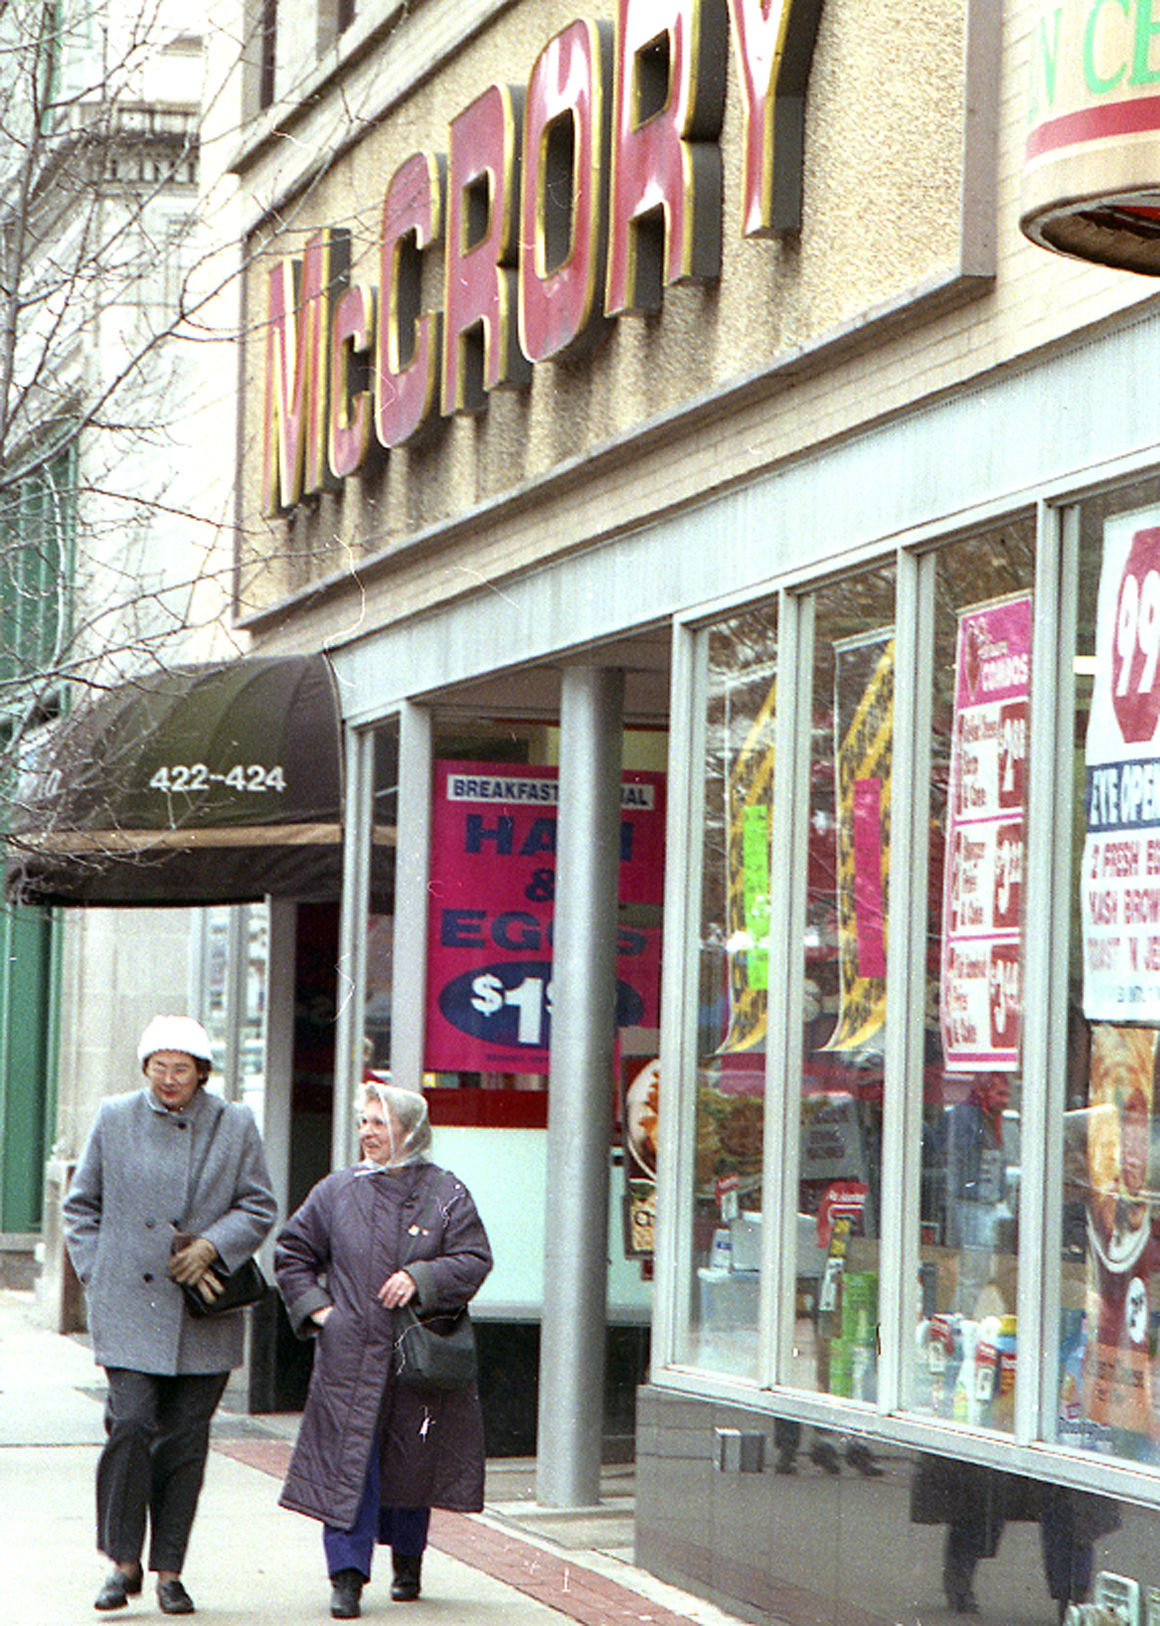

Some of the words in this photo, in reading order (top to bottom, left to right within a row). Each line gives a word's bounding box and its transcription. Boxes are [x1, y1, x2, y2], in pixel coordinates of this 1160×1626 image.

[1116, 569, 1160, 697] 99
[149, 762, 288, 793] 422-424
[452, 778, 560, 801] BREAKFAST
[465, 813, 633, 861] HA
[440, 907, 647, 955] EGS
[470, 972, 552, 1044] $1
